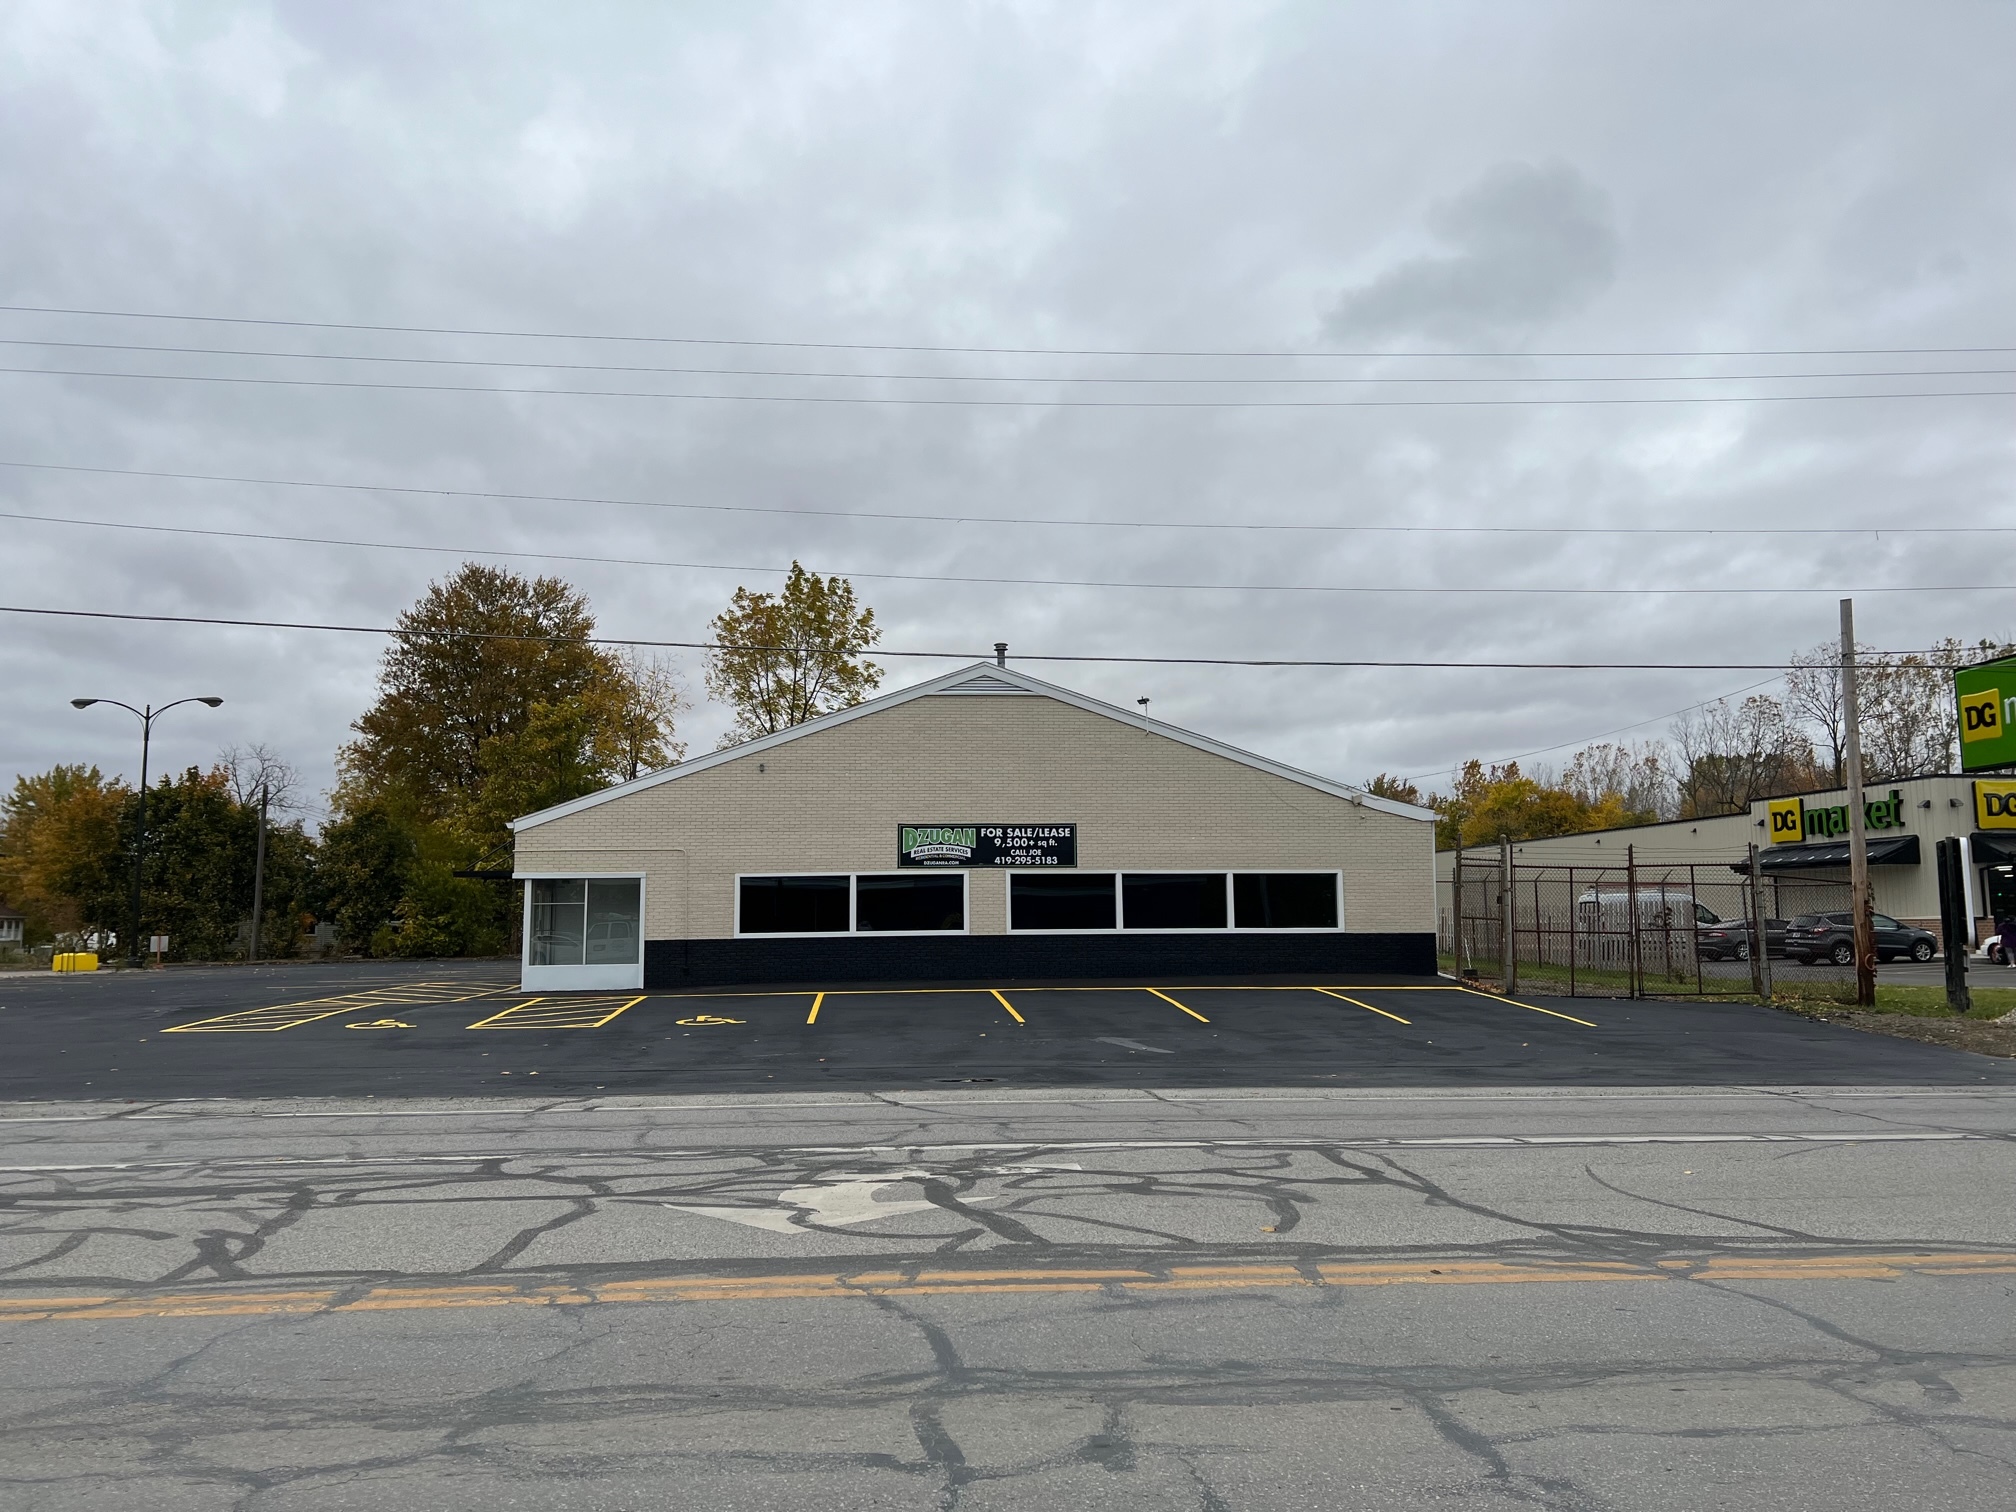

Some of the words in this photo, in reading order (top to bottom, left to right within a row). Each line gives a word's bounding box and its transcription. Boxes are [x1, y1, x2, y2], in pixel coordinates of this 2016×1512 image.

[1964, 702, 1997, 731] DG
[1983, 792, 2016, 817] DG
[1772, 810, 1797, 832] DG
[903, 828, 977, 853] DZUGAN
[980, 828, 1003, 837] FOR
[1006, 827, 1071, 838] SALE/LEASE
[994, 838, 1035, 848] 9,500+
[1037, 840, 1047, 848] sq
[1049, 838, 1058, 846] ft.
[913, 848, 926, 856] REAL
[945, 847, 969, 855] SERVICES
[994, 856, 1058, 865] 419-295-5183
